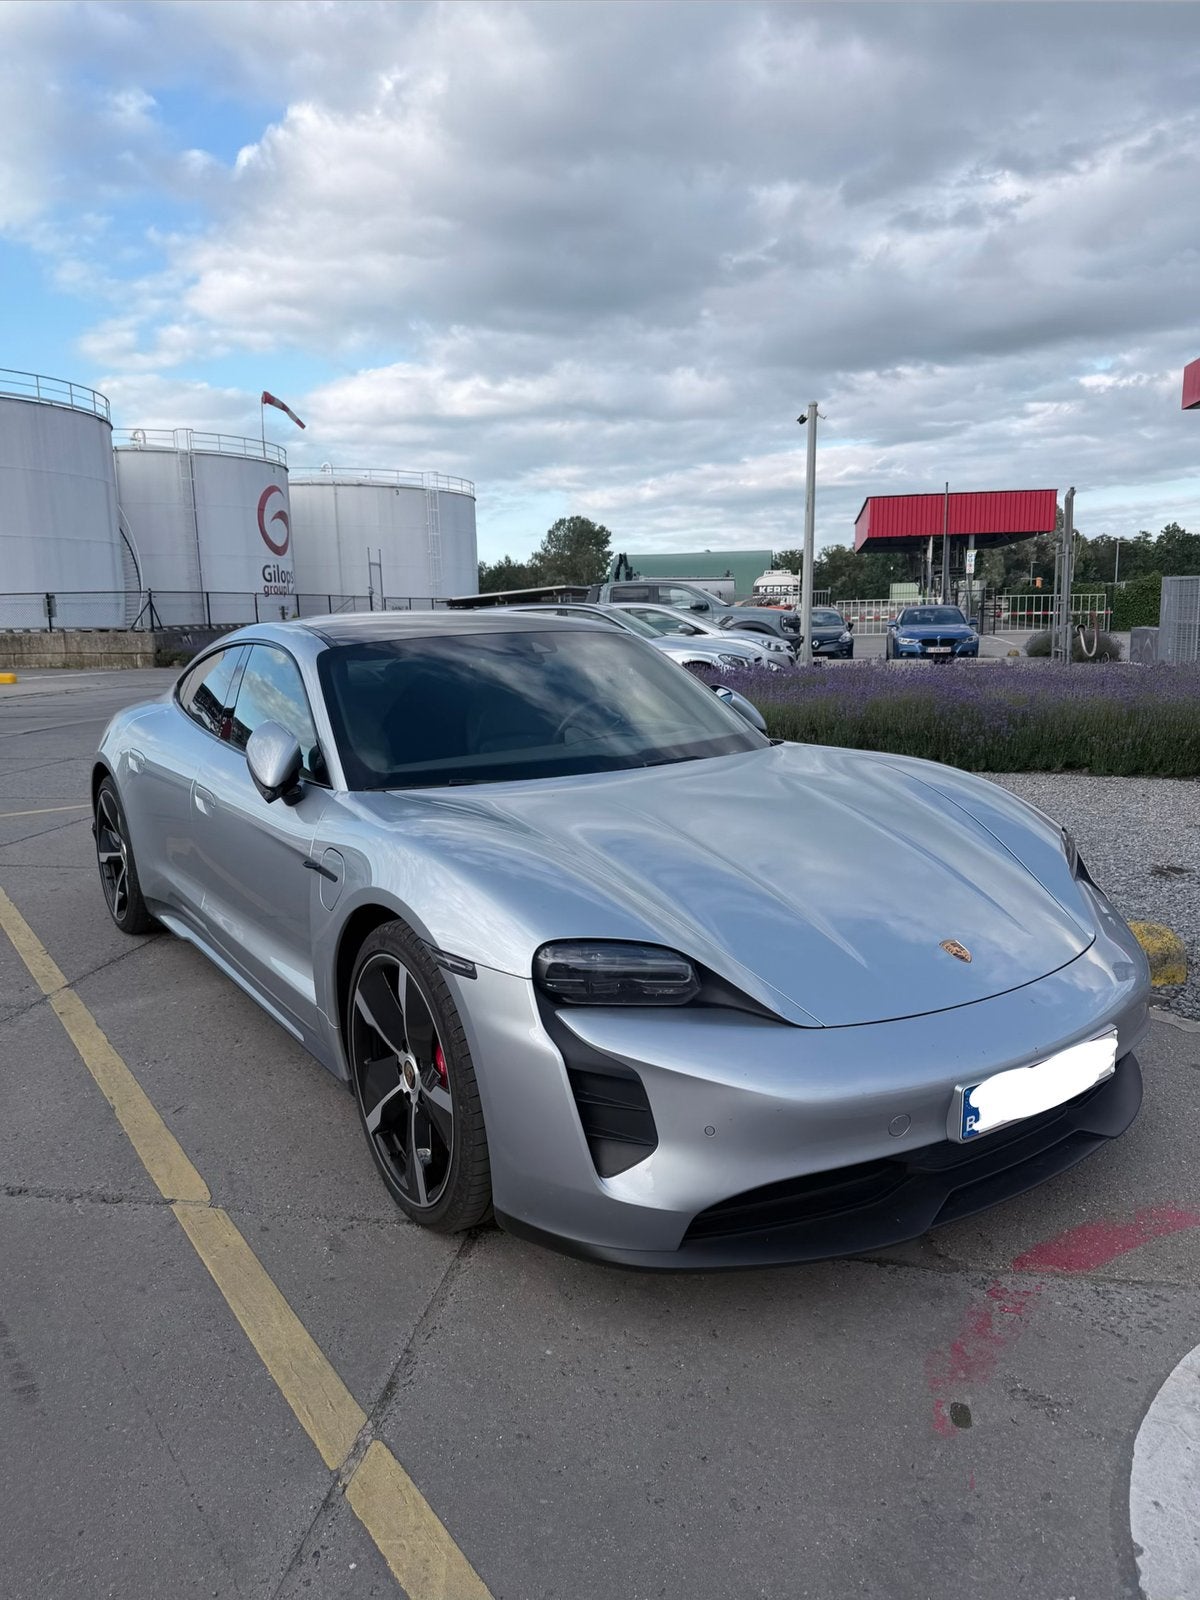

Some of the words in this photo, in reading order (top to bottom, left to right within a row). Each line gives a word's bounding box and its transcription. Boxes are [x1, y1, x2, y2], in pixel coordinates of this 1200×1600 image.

[262, 564, 294, 584] Gilops
[263, 584, 288, 597] group
[966, 1115, 976, 1131] B
